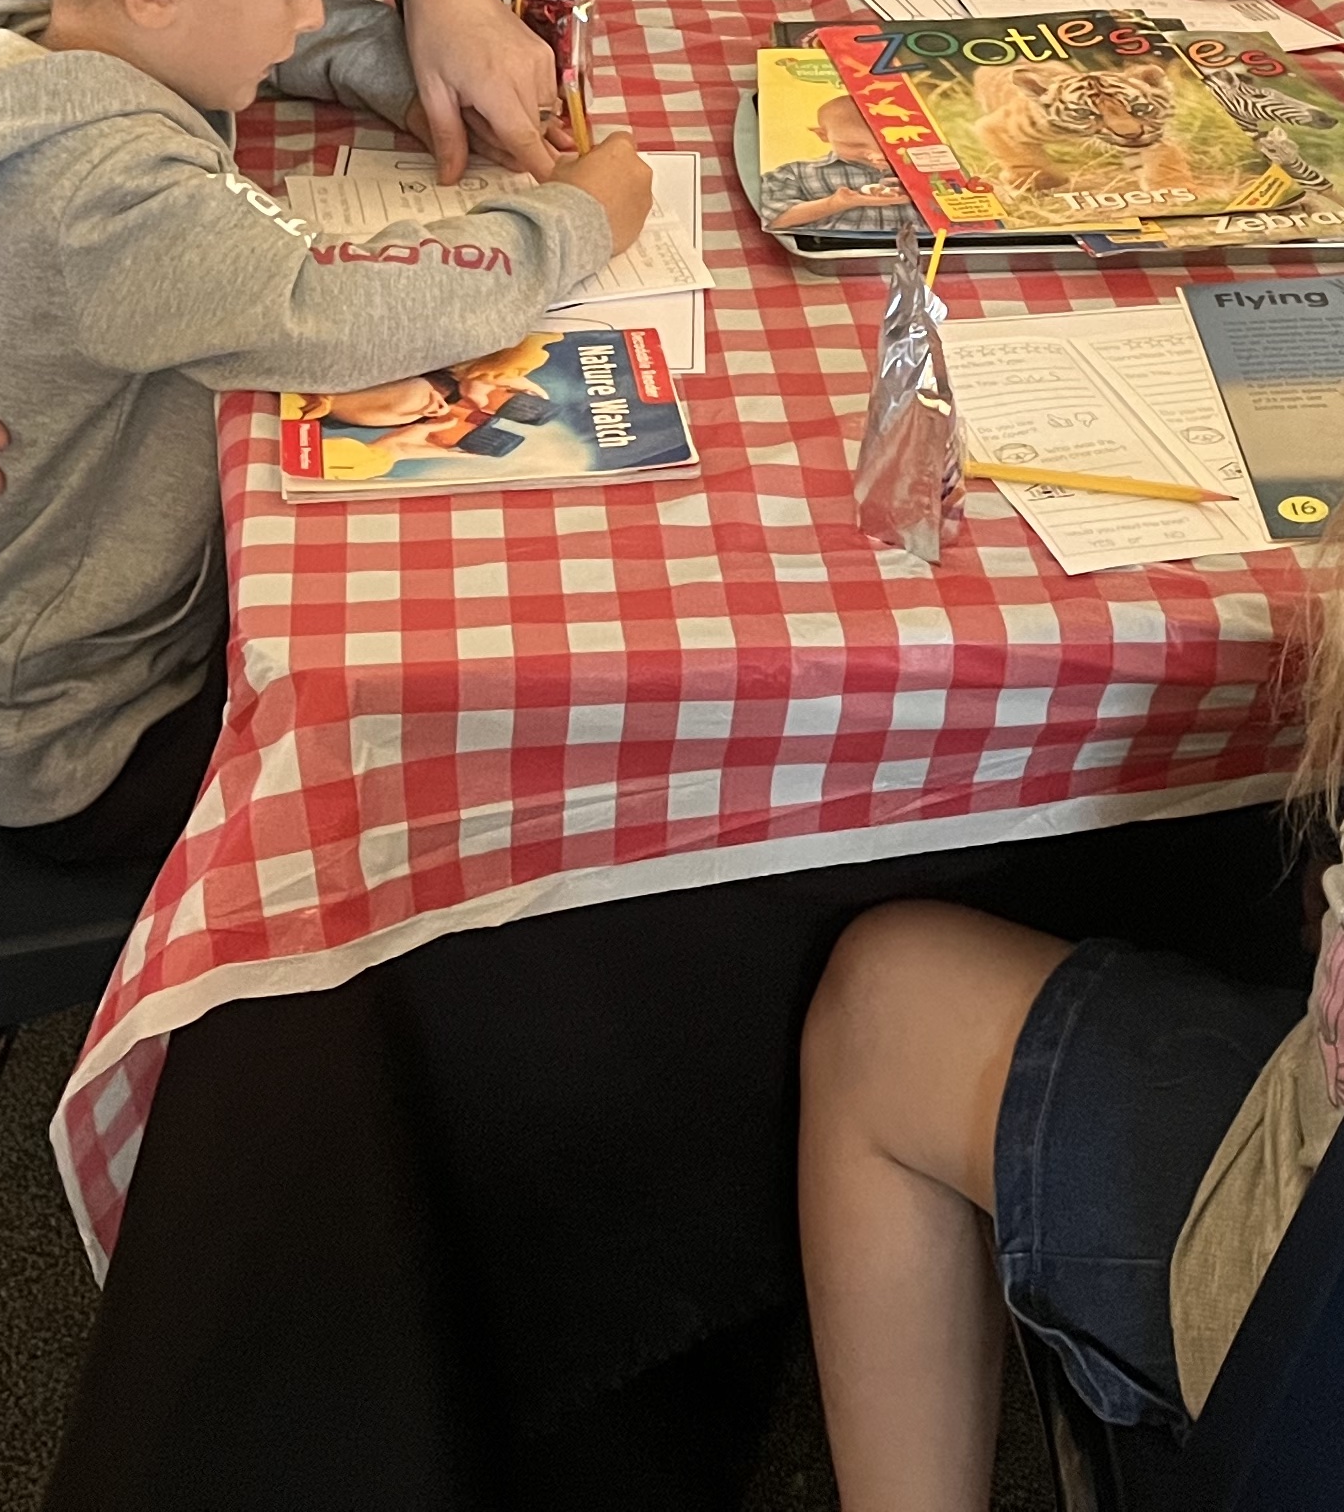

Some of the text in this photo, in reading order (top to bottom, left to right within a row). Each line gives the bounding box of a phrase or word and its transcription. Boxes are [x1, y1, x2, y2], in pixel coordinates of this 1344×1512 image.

[854, 19, 1152, 76] Zootles
[1053, 186, 1198, 211] Tigers
[1214, 290, 1330, 310] Flying
[577, 344, 637, 448] Nature Watch
[1290, 500, 1318, 516] 16
[1163, 529, 1189, 541] NO
